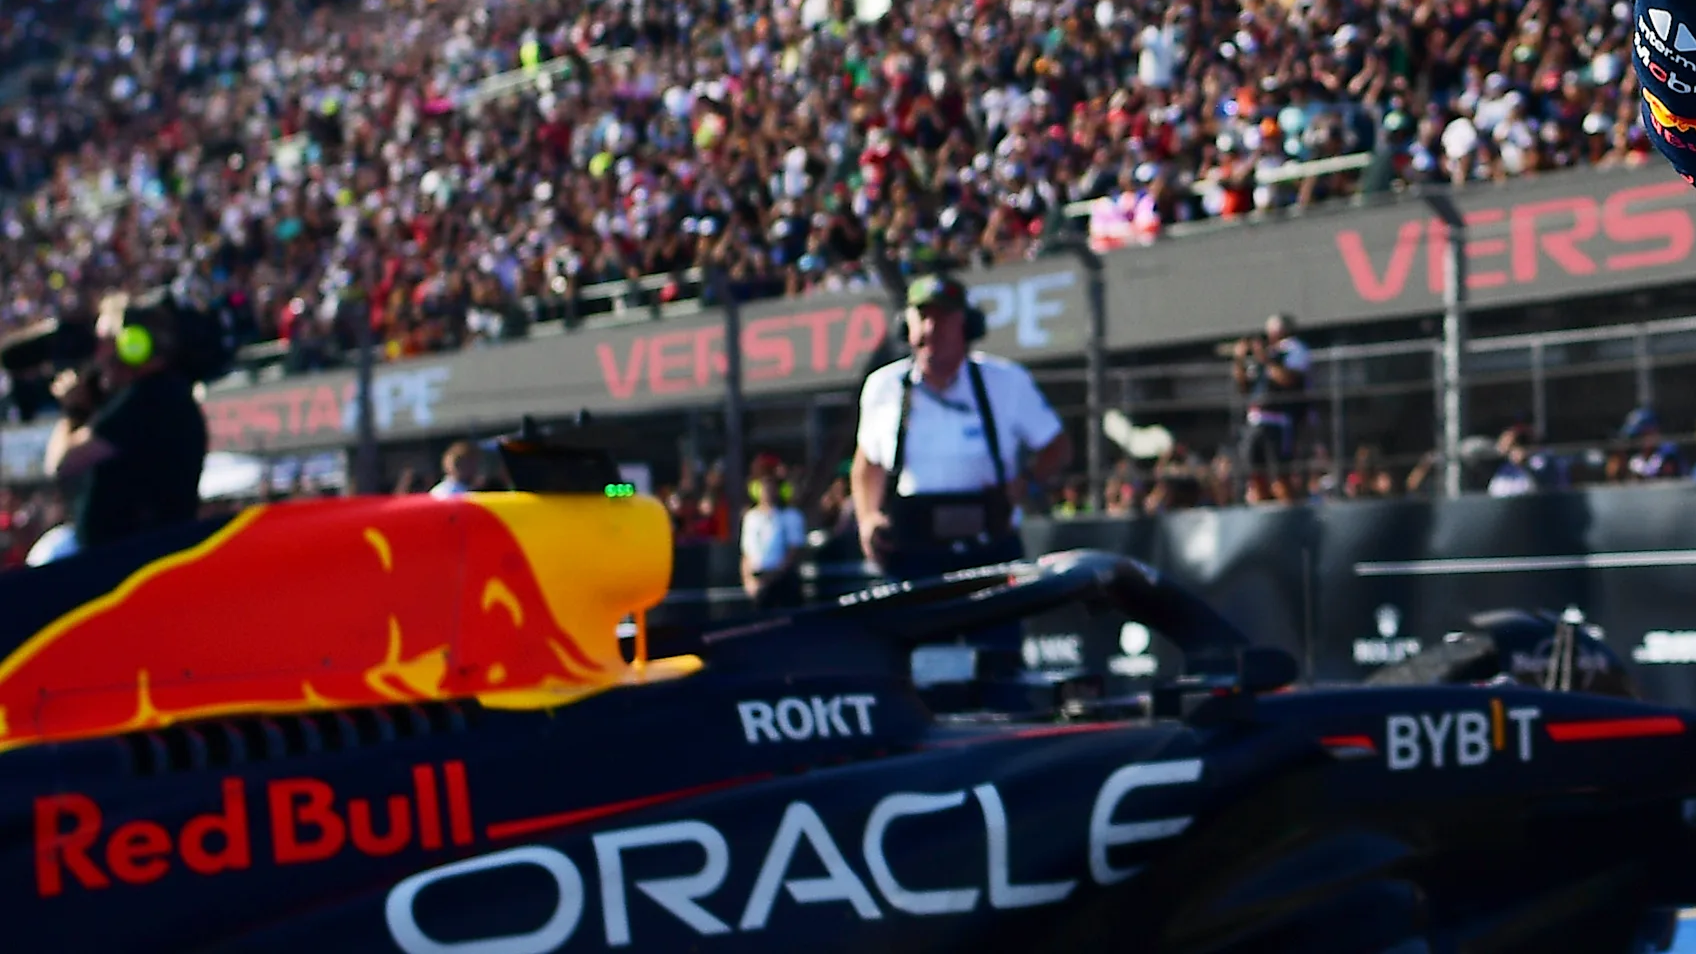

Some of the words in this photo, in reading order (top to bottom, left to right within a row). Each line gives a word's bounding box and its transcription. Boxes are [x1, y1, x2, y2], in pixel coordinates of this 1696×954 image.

[738, 694, 877, 744] ROKT
[1386, 697, 1542, 771] BYBIT
[32, 775, 251, 897] Red
[268, 759, 476, 864] Bull
[385, 758, 1203, 954] ORACLE
